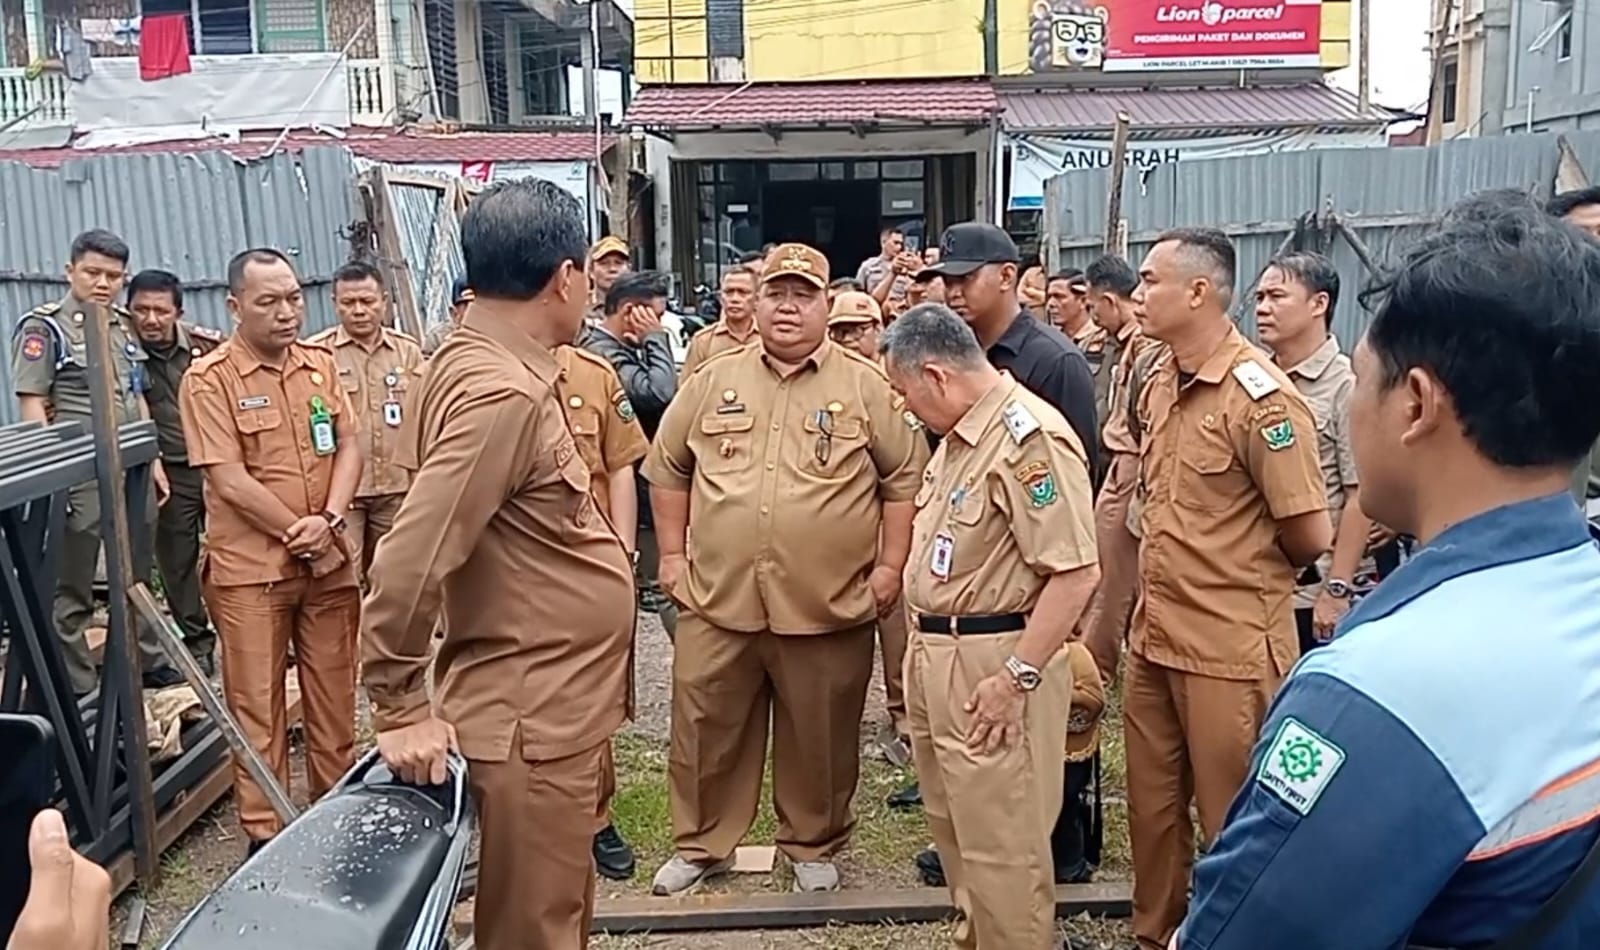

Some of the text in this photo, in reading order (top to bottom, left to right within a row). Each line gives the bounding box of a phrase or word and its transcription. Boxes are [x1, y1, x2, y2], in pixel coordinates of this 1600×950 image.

[1156, 4, 1284, 24] Lion parcel
[1134, 30, 1306, 44] PENGIRIMAN PAKET DAN DOKUMEN
